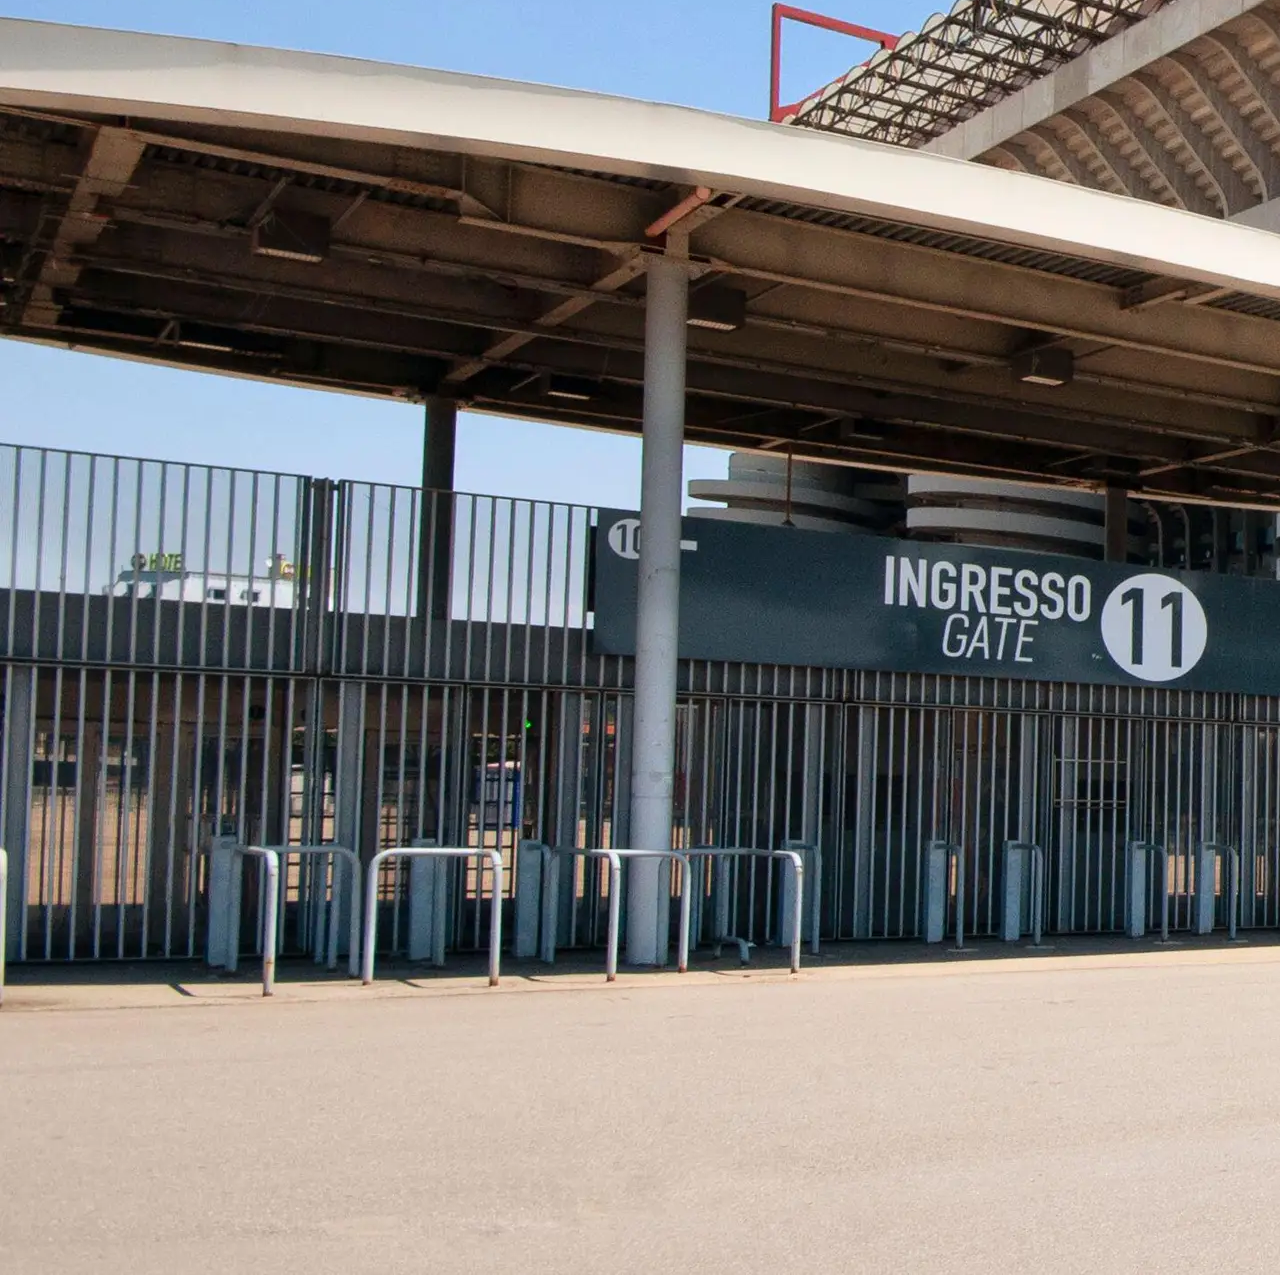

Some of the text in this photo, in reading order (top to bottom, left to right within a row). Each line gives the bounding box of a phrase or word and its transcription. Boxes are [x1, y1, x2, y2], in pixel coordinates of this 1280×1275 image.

[884, 555, 1183, 668] INGRESSO 11
[942, 613, 1039, 663] GATE
